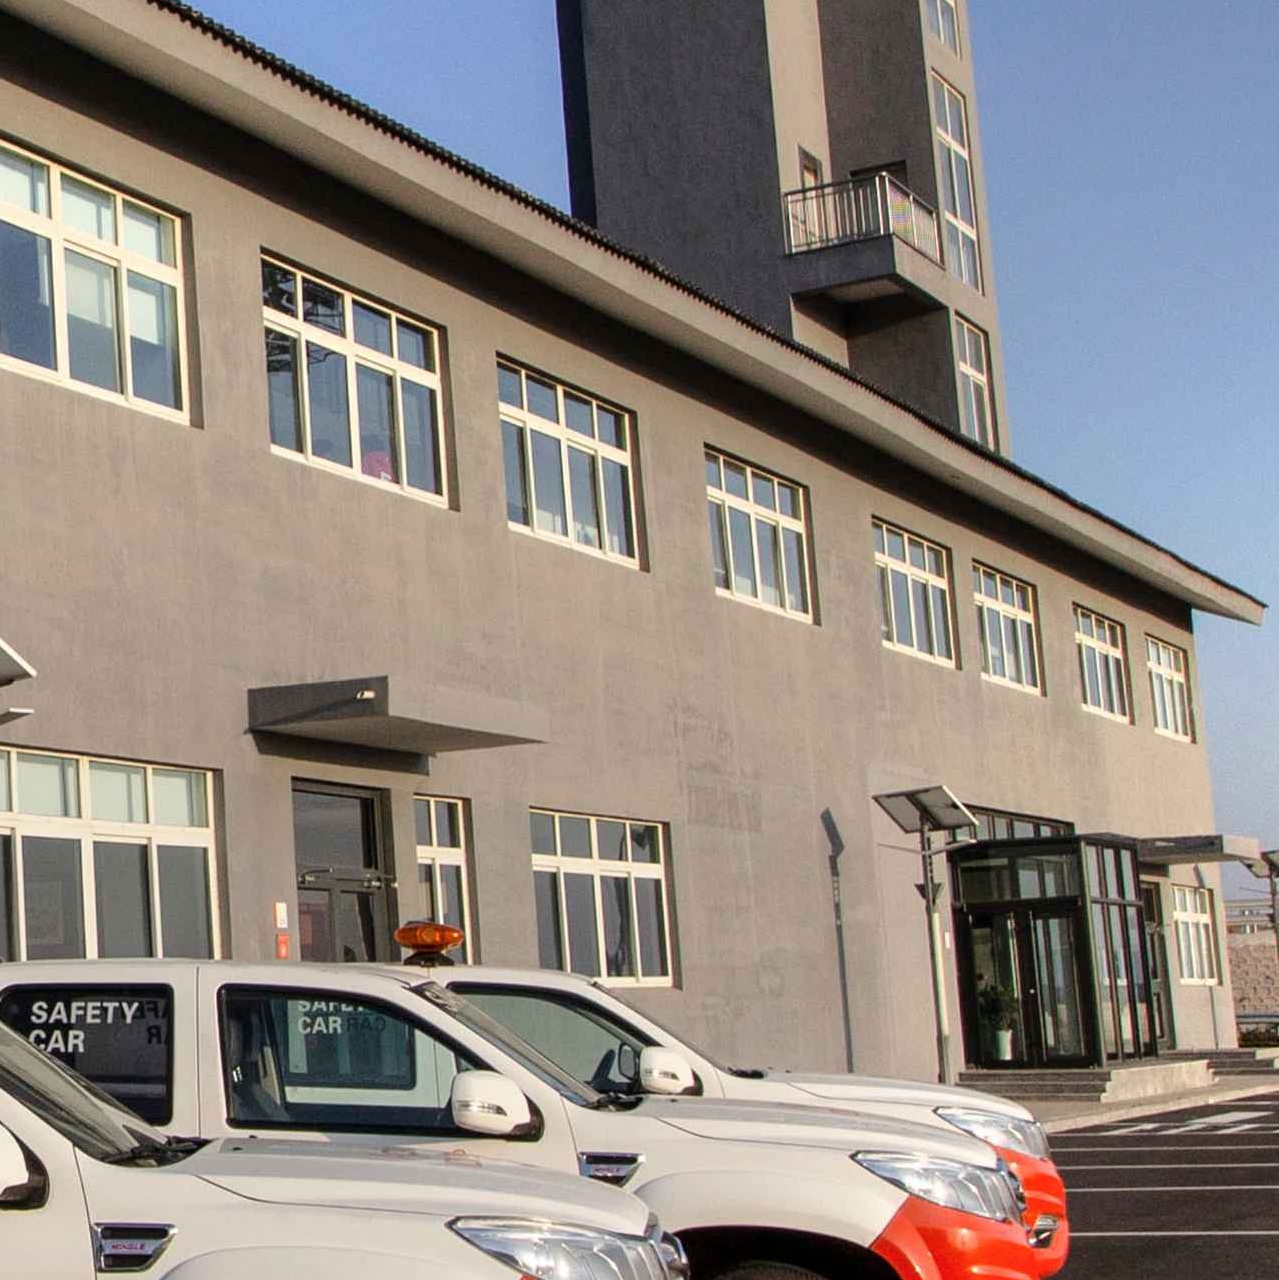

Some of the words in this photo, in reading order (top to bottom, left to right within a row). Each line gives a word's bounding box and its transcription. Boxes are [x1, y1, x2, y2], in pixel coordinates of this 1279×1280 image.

[30, 1001, 140, 1024] SAFETY
[298, 1016, 342, 1034] CAR
[28, 1029, 86, 1053] CAR
